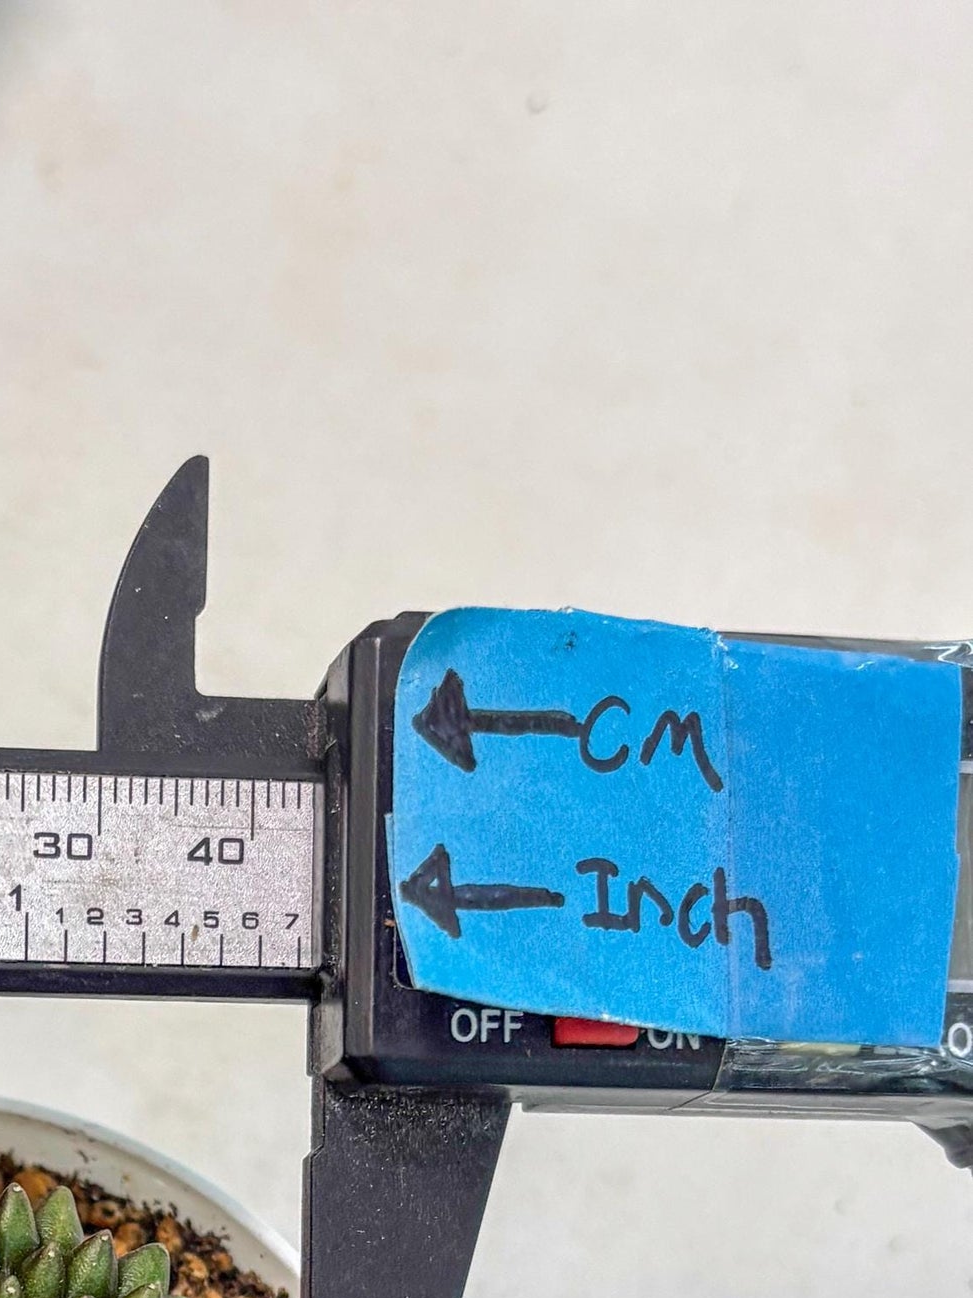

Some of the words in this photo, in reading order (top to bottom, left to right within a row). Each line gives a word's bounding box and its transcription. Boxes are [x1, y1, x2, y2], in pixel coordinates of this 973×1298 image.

[33, 832, 93, 861] 30
[187, 837, 244, 866] 40
[8, 884, 23, 911] 1
[55, 907, 64, 923] 1
[86, 907, 104, 924] 2
[126, 909, 143, 925] 3
[163, 910, 180, 926] 4
[203, 911, 220, 928] 5
[242, 912, 259, 929] 6
[284, 914, 299, 929] 7
[576, 857, 772, 970] Inch
[451, 1008, 524, 1043] OFF
